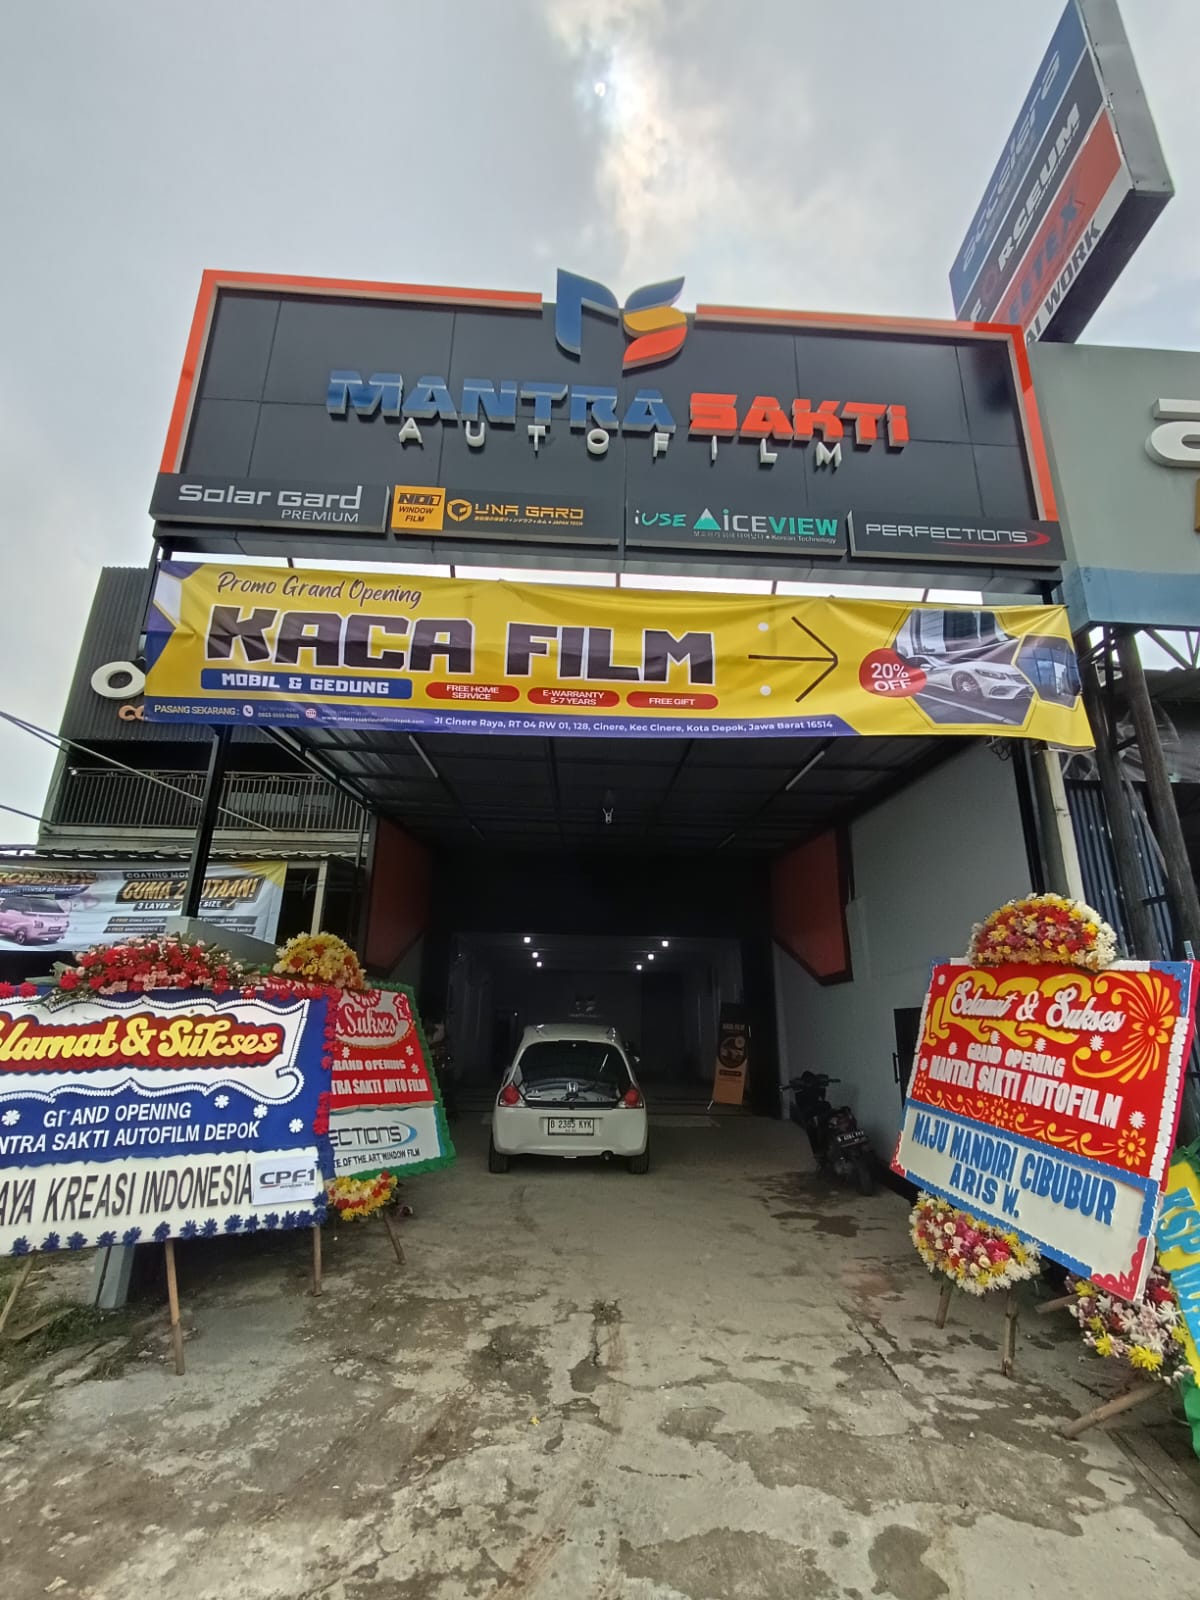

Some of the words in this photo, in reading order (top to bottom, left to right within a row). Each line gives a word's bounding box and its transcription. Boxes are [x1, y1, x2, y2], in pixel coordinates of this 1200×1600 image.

[1044, 219, 1101, 316] WORK
[326, 370, 676, 433] MANTRA
[688, 392, 909, 447] SAKTI
[179, 484, 271, 505] Solar
[277, 485, 363, 510] Gard
[281, 509, 359, 523] PREMIUM
[399, 506, 434, 514] WINDOW
[525, 506, 584, 519] GARD
[866, 524, 1028, 543] PERFECTIONS
[218, 571, 276, 595] Promo
[282, 575, 346, 599] Grand
[349, 579, 422, 610] Opening
[204, 604, 474, 675] KACA
[504, 621, 716, 686] FILM
[871, 662, 909, 679] 20%
[222, 673, 280, 688] MOBIL
[288, 677, 303, 689] &
[310, 678, 390, 694] GEDUNG
[446, 684, 470, 692] FREE
[470, 686, 499, 694] HOME
[874, 678, 912, 691] OFF
[452, 692, 491, 700] SERVICE
[543, 690, 604, 699] E-WARRANTY
[649, 697, 673, 705] FREE
[674, 698, 696, 706] GIFT
[154, 704, 190, 714] PASANG
[445, 717, 478, 726] Cinere
[480, 719, 506, 729] Raya,
[508, 720, 522, 728] RT
[538, 721, 556, 729] RW
[558, 722, 571, 731] 01,
[573, 722, 591, 732] 128,
[593, 722, 627, 732] Cinere,
[629, 723, 648, 731] Kec
[650, 723, 685, 733] Cinere,
[686, 724, 710, 732] Kota
[712, 723, 747, 733] Depok,
[749, 723, 775, 731] Jawa
[777, 721, 804, 729] Barat
[806, 720, 833, 729] 16514
[122, 881, 174, 900] CUMA
[174, 881, 188, 900] 2
[203, 900, 222, 908] SIZE
[950, 980, 1017, 1018] Selamat
[1016, 990, 1039, 1021] &
[1046, 986, 1126, 1033] Sukses
[344, 1005, 396, 1034] Sukses
[120, 1017, 157, 1056] &
[364, 1059, 407, 1071] OPENING
[967, 1042, 1002, 1064] GRAND
[1005, 1049, 1066, 1078] OPENING
[352, 1078, 382, 1094] SAKTI
[383, 1078, 407, 1093] AUTO
[407, 1078, 428, 1092] FILM
[929, 1055, 975, 1088] MANTRA
[977, 1065, 1021, 1101] SAKTI
[1023, 1079, 1123, 1129] AUTOFILM
[115, 1102, 192, 1123] OPENING
[52, 1129, 109, 1150] SAKTI
[114, 1123, 200, 1146] AUTOFILM
[203, 1120, 260, 1141] DEPOK
[343, 1156, 353, 1166] OF
[353, 1154, 367, 1165] THE
[368, 1152, 381, 1162] ART
[381, 1148, 406, 1161] WINDOW
[407, 1147, 420, 1157] FILM
[260, 1168, 315, 1185] CPF1
[912, 1112, 950, 1153] MAJU
[949, 1126, 1019, 1183] MANDIRI
[1019, 1152, 1118, 1226] CIBUBUR
[43, 1172, 136, 1224] KREASI
[140, 1163, 252, 1214] INDONESIA
[949, 1163, 999, 1205] ARIS
[1002, 1185, 1021, 1219] W.
